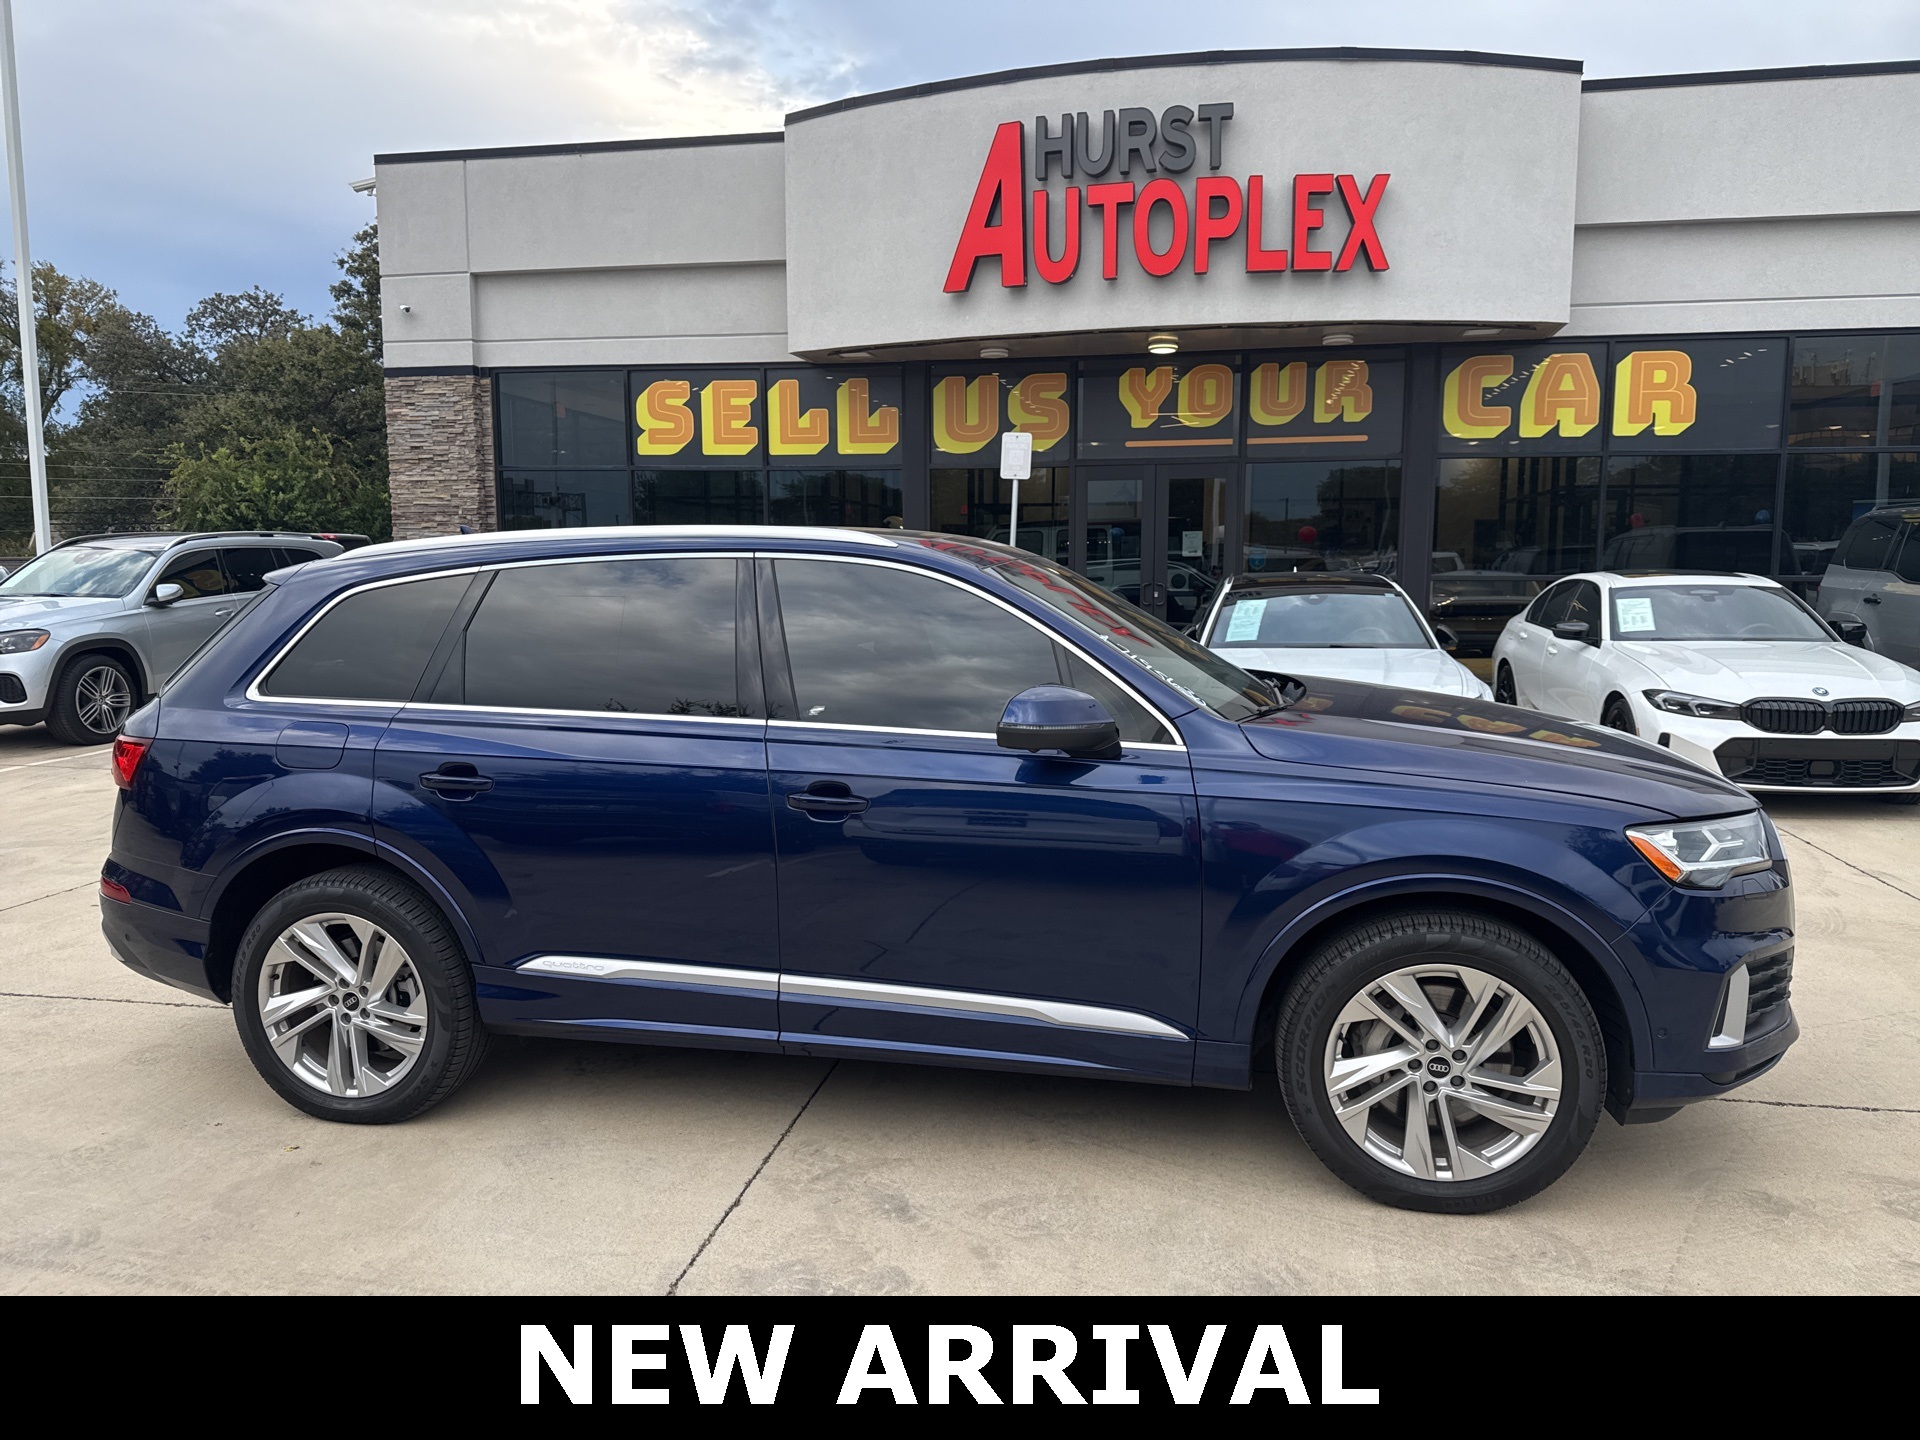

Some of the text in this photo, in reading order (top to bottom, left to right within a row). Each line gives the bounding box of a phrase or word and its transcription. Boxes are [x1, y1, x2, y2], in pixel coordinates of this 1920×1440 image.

[1035, 102, 1234, 181] HURST
[943, 121, 1391, 293] AUTOPLEX
[636, 351, 1697, 455] SELL US YOUR CAR
[542, 960, 605, 971] quattro
[1295, 984, 1338, 1096] SCORPION
